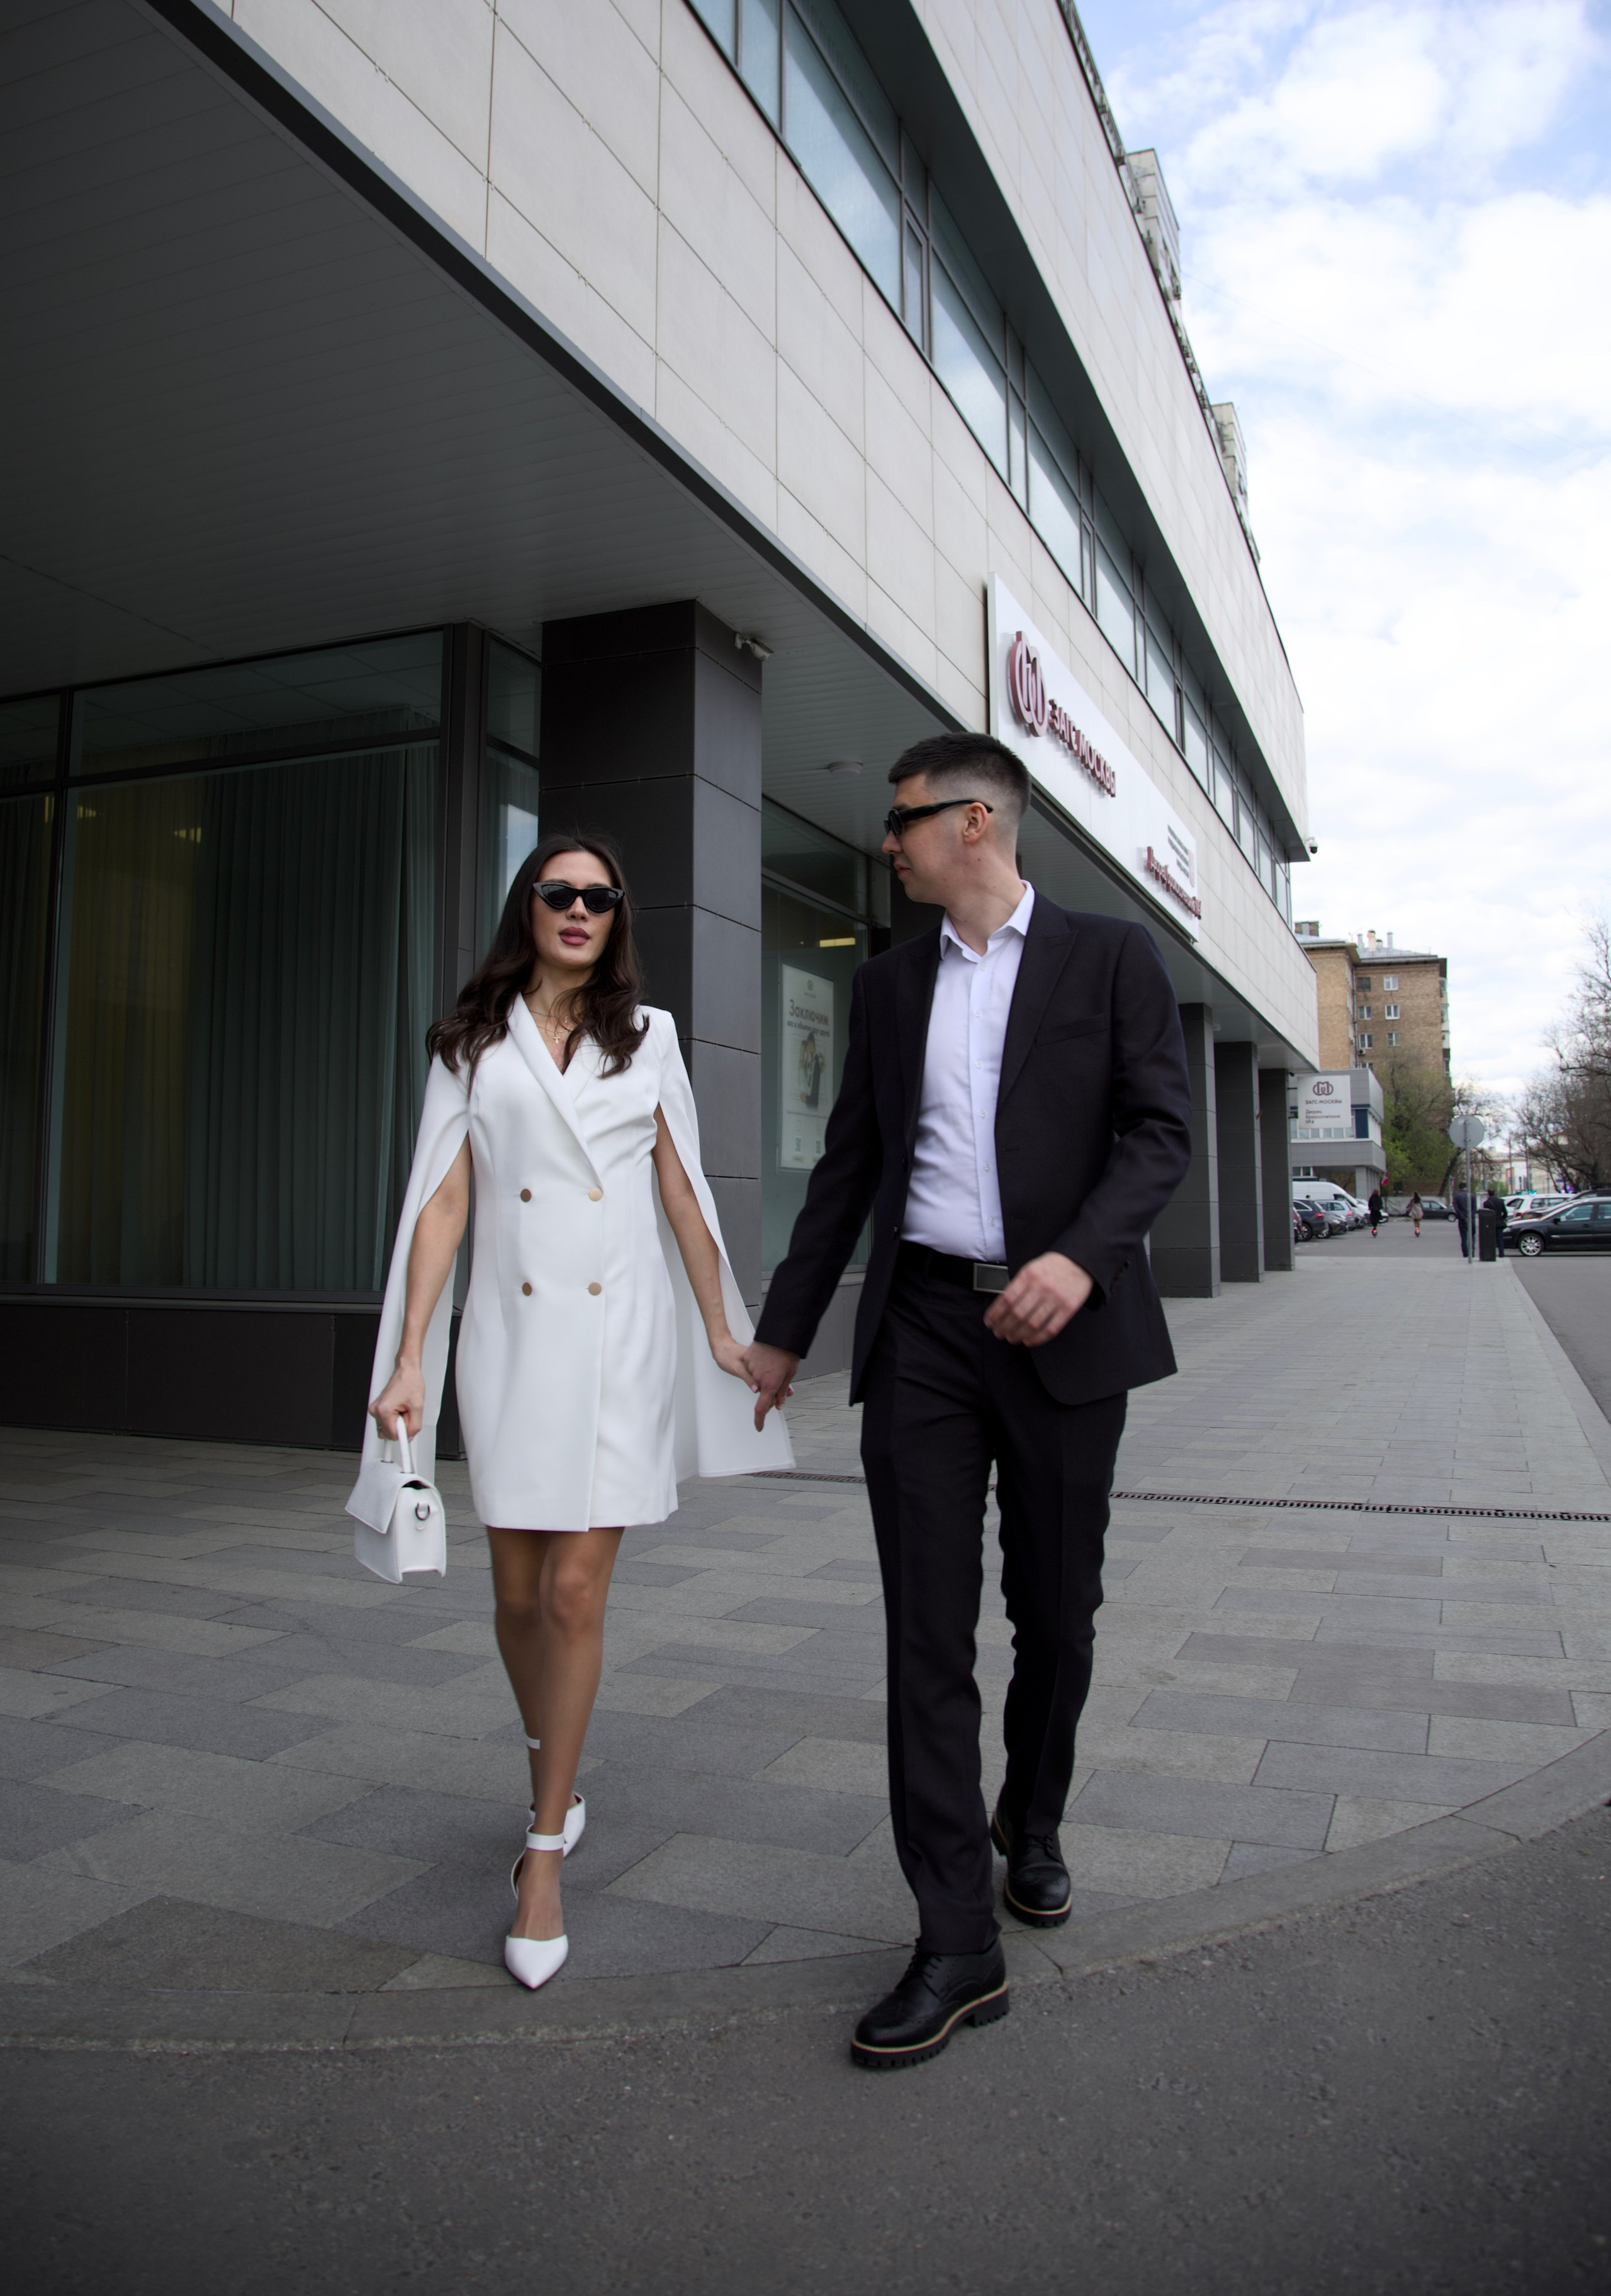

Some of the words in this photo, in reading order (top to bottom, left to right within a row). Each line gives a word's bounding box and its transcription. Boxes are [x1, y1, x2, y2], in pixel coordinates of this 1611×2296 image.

[1048, 699, 1077, 751] ЗАГС
[1075, 729, 1116, 797] МОСКВЫ
[789, 999, 829, 1026] Заключим
